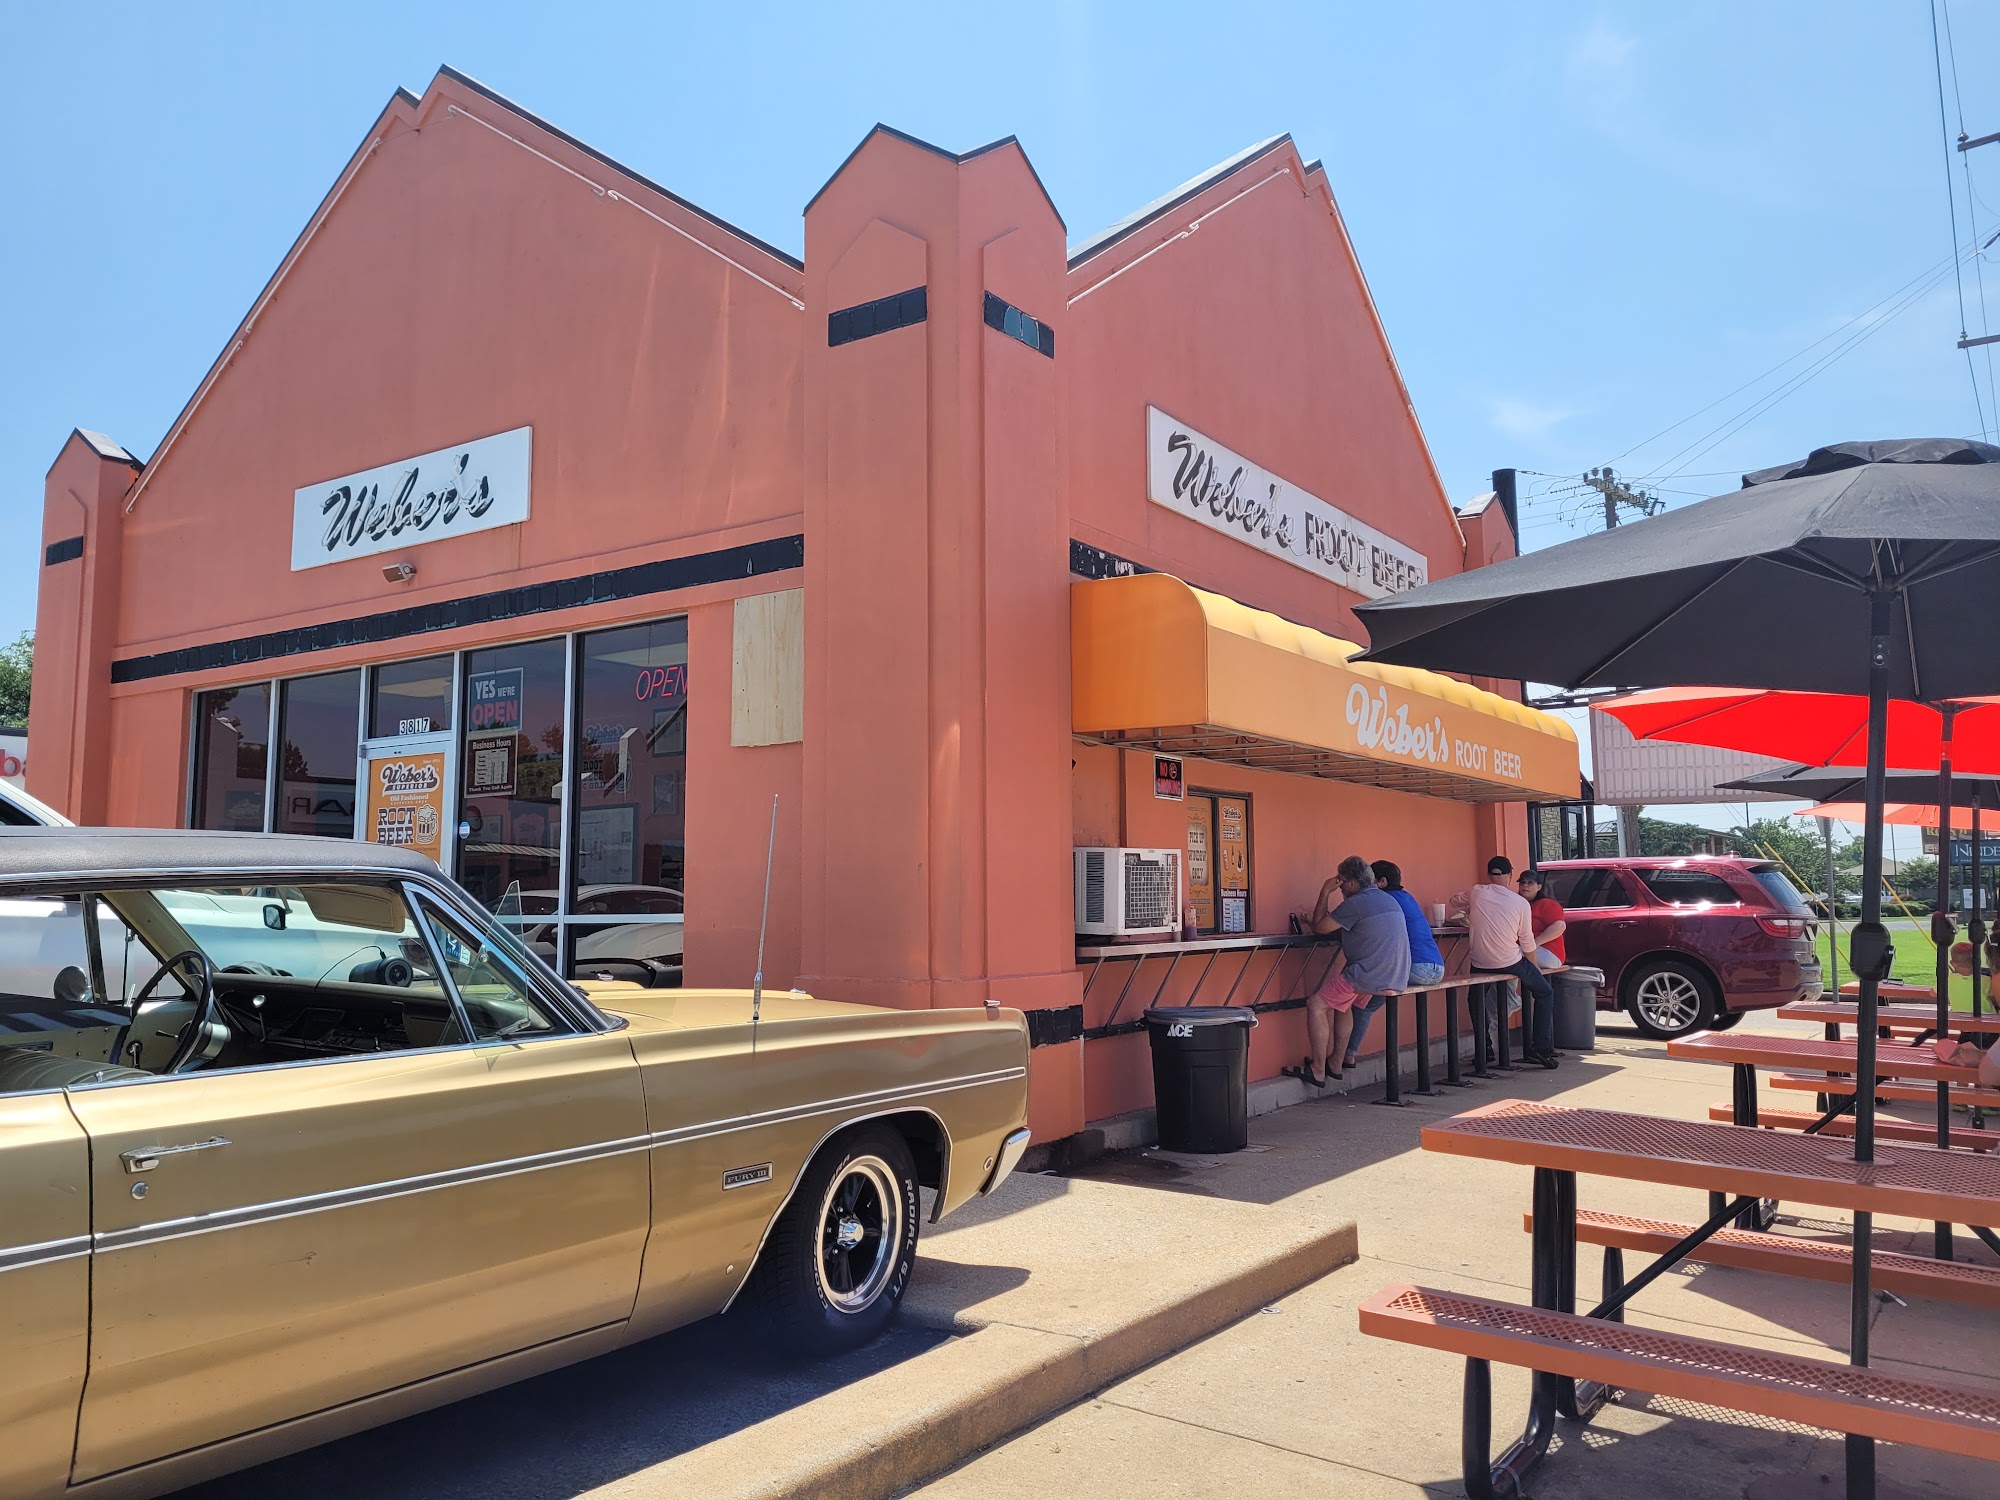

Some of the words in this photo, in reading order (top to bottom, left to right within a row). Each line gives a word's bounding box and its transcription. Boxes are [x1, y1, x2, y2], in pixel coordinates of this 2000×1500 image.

[321, 454, 494, 551] Weber's
[1168, 431, 1298, 549] Weber's
[1305, 511, 1372, 577] ROOT
[475, 680, 495, 700] YES
[497, 686, 516, 697] WE'RE
[636, 666, 688, 700] OPEN
[471, 700, 518, 725] OPEN
[400, 718, 429, 734] 3817
[1345, 683, 1449, 763] Weber's
[1455, 739, 1488, 771] ROOT
[1494, 748, 1522, 780] BEER
[472, 741, 496, 750] Business
[496, 738, 511, 748] Hours
[382, 764, 434, 784] Weber's
[1160, 761, 1168, 777] NO
[392, 783, 428, 791] SUPERIOR
[1157, 778, 1180, 795] SMOKING
[378, 806, 416, 826] ROOT
[377, 826, 414, 845] BEER
[1220, 888, 1237, 898] Business
[1236, 889, 1248, 898] Hours
[1166, 1022, 1194, 1037] ACE
[726, 1171, 756, 1183] FURY
[757, 1169, 767, 1178] III
[904, 1179, 917, 1251] RADIAL
[892, 1260, 909, 1298] G/T
